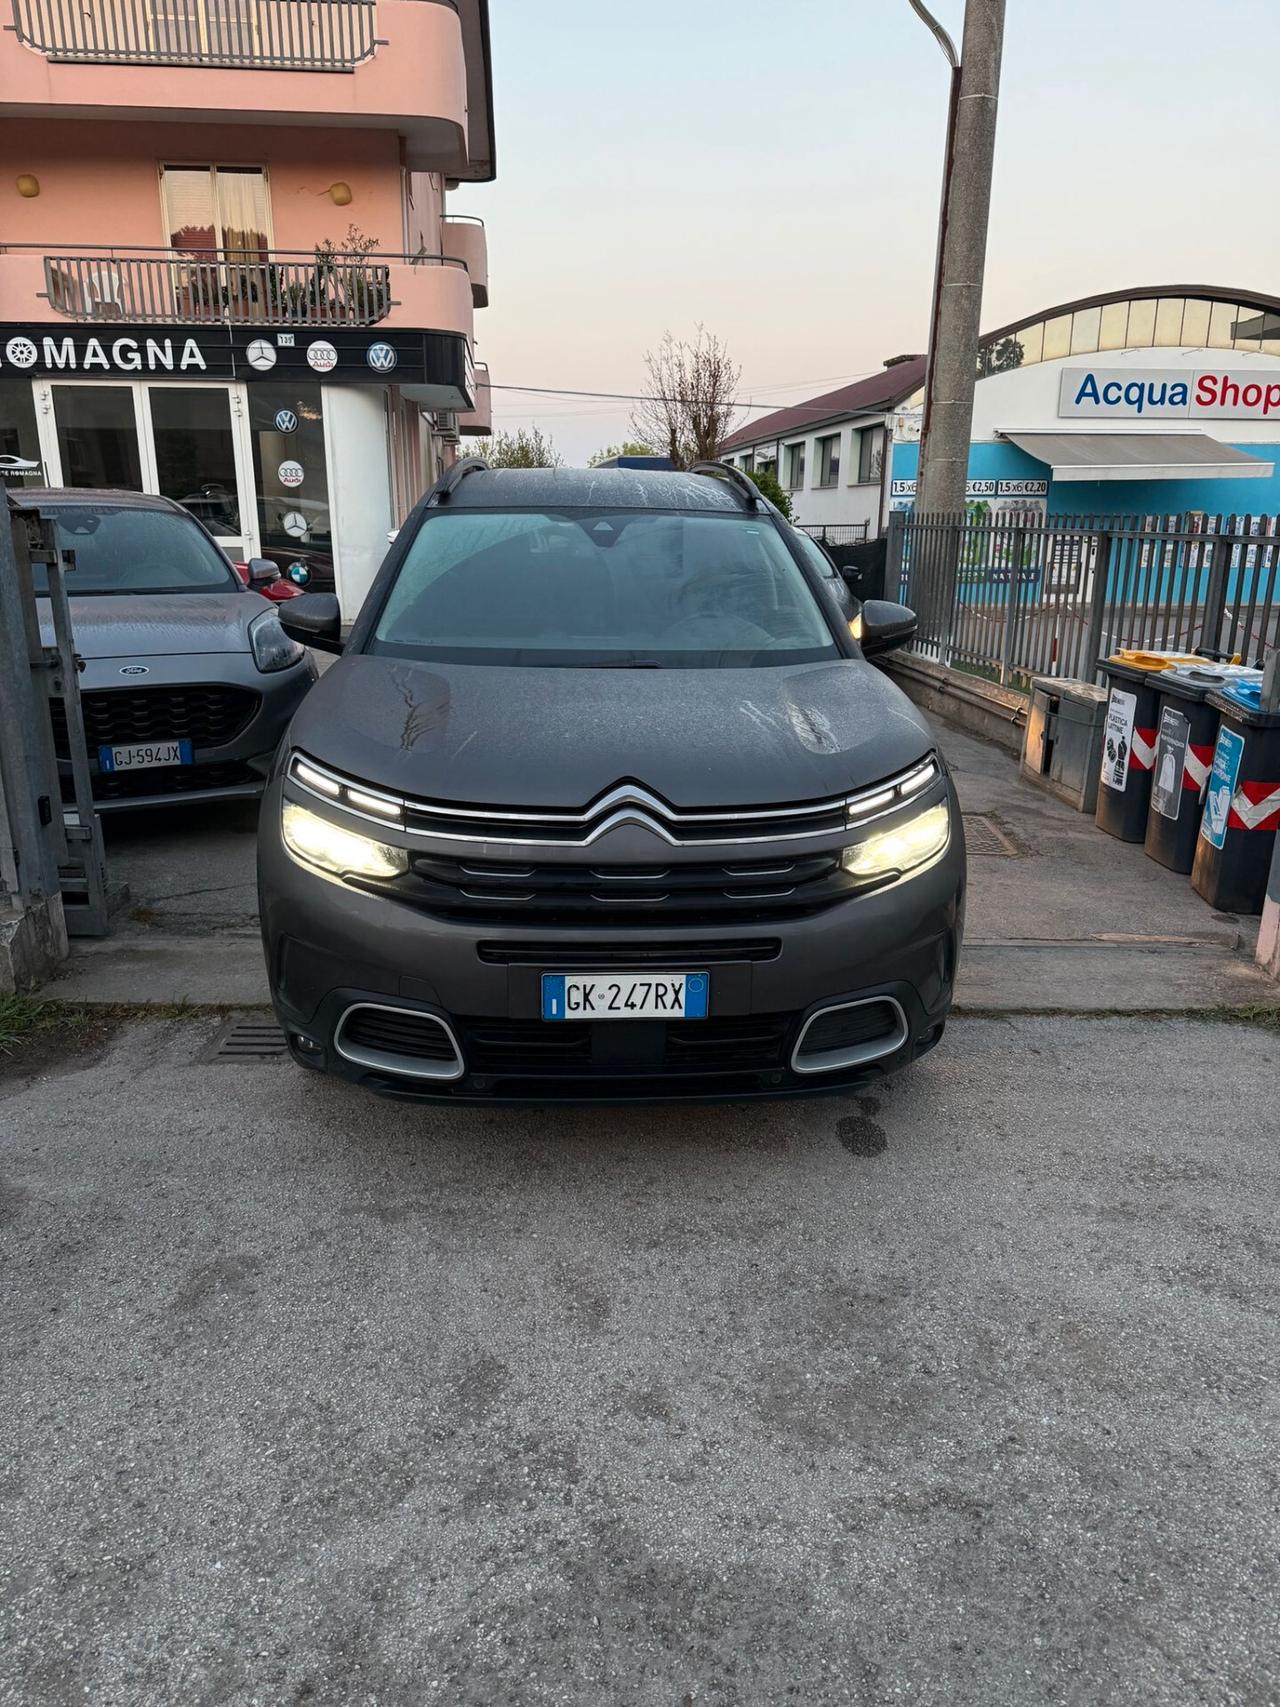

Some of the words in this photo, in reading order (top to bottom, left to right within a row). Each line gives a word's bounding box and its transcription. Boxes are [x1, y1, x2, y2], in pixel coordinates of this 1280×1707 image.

[0, 336, 207, 371] OMAGNA
[1074, 373, 1189, 414] Acqua
[1195, 374, 1280, 415] Shop
[972, 481, 995, 493] €2,50
[999, 481, 1012, 493] 1,5
[1012, 482, 1023, 492] x6
[1024, 481, 1047, 493] €2,20
[114, 750, 132, 767] GJ
[136, 746, 180, 764] 594JX
[567, 984, 596, 1011] GK
[607, 983, 684, 1010] 247RX
